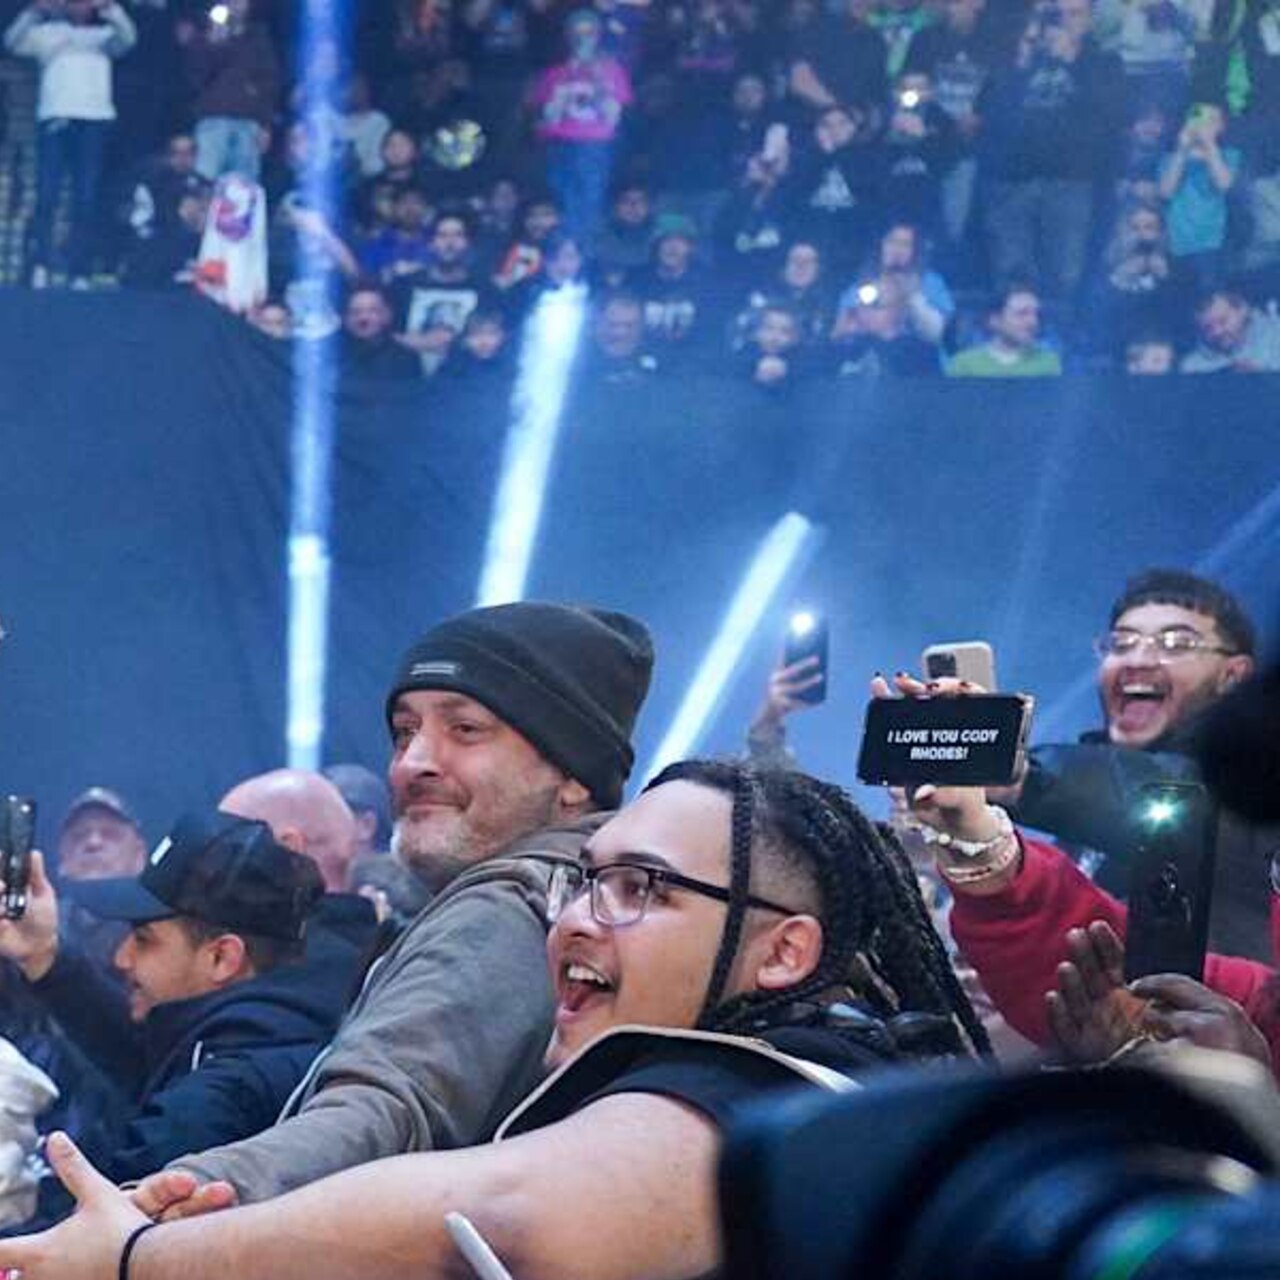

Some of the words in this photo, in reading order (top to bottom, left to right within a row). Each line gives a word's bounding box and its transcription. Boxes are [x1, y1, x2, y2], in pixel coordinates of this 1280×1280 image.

[887, 730, 893, 743] I
[895, 730, 929, 743] LOVE
[931, 729, 958, 743] YOU
[961, 729, 999, 742] CODY
